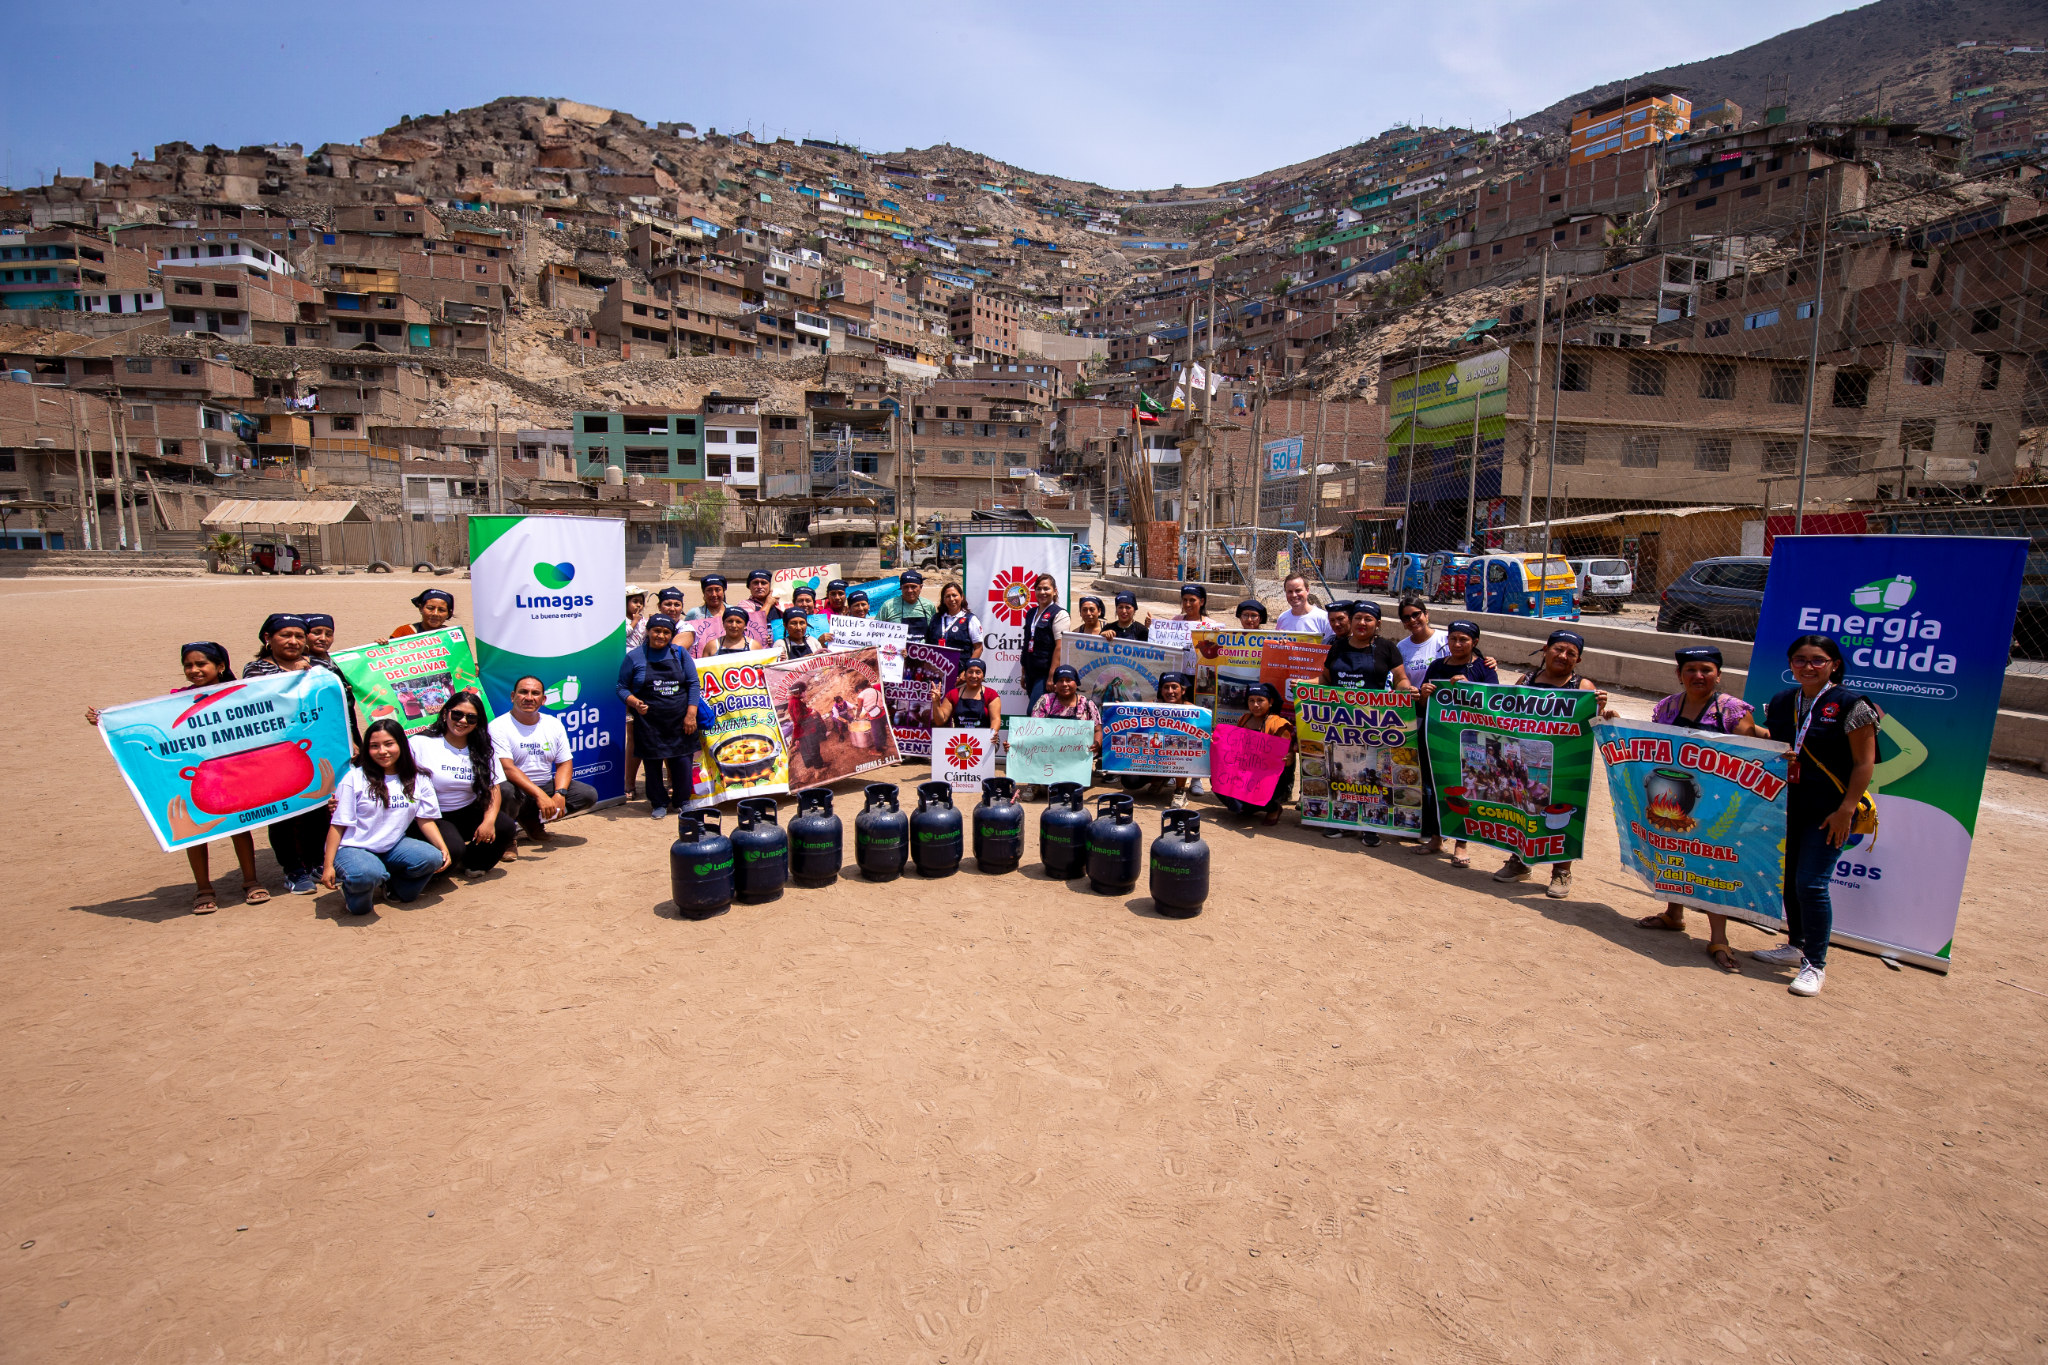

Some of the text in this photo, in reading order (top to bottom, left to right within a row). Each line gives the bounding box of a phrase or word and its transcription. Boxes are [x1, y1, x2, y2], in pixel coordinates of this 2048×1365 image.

[1474, 365, 1499, 378] ANDINO
[1397, 381, 1442, 402] PROGRESOL
[1273, 452, 1286, 470] 50
[774, 565, 829, 582] GRACIAS
[516, 594, 594, 610] Limagas
[832, 617, 865, 628] MUCHAS
[869, 621, 902, 631] GRACIAS
[1154, 621, 1189, 631] GRACIAS
[1798, 607, 1942, 643] Energía
[366, 636, 442, 659] OLLA COMÚN
[983, 633, 1022, 650] Cári
[1217, 634, 1245, 646] OLLA
[1840, 635, 1874, 647] que
[995, 651, 1020, 662] Chos
[1075, 640, 1111, 654] OLLA
[1114, 641, 1165, 661] COMÚN
[1217, 648, 1262, 658] COMITE DE
[368, 647, 451, 672] LA FORTALEZA
[908, 645, 956, 676] COMUN
[1852, 644, 1957, 674] cuida
[385, 660, 448, 680] DEL OLÍVAR
[898, 680, 928, 690] HIJOS
[1863, 681, 1884, 689] CON
[1886, 682, 1945, 696] PROPÓSITO
[886, 689, 917, 700] SANTA
[1296, 686, 1412, 707] OLLA COMÚN
[1436, 688, 1576, 717] OLLA COMÚN
[188, 700, 275, 729] OLLA COMUN
[556, 703, 600, 732] rgía
[1117, 707, 1199, 718] OLLA COMUN
[1301, 703, 1406, 728] JUANA
[1111, 717, 1138, 733] DIOS
[1140, 717, 1157, 728] ES
[1310, 723, 1326, 733] DE
[1440, 709, 1581, 736] LA NUEVA ESPERANZA
[159, 734, 207, 756] NUEVO
[212, 717, 287, 745] AMANECER
[570, 727, 610, 753] uida
[893, 727, 931, 741] MUNA
[1324, 725, 1406, 747] ARCO
[575, 764, 606, 777] PROPÓSITO
[944, 772, 981, 782] Cáritas
[1043, 764, 1054, 776] 5
[1600, 738, 1788, 802] OLLITA COMÚN
[1331, 782, 1389, 795] COMUNA 5
[1341, 793, 1379, 803] PRESENTE
[239, 801, 289, 824] COMUNA 5
[1527, 818, 1538, 833] 5
[871, 836, 900, 845] Limagas
[934, 829, 961, 840] Limagas
[1464, 818, 1565, 857] PRESENTE
[1631, 821, 1739, 863] SAN CRISTÓBAL
[803, 842, 834, 850] Limagas
[1091, 846, 1120, 856] Limagas
[713, 858, 734, 871] Limag
[1157, 863, 1190, 874] Limagas
[1668, 855, 1685, 867] FF.
[1663, 868, 1684, 881] del
[1655, 882, 1694, 894] muna 5
